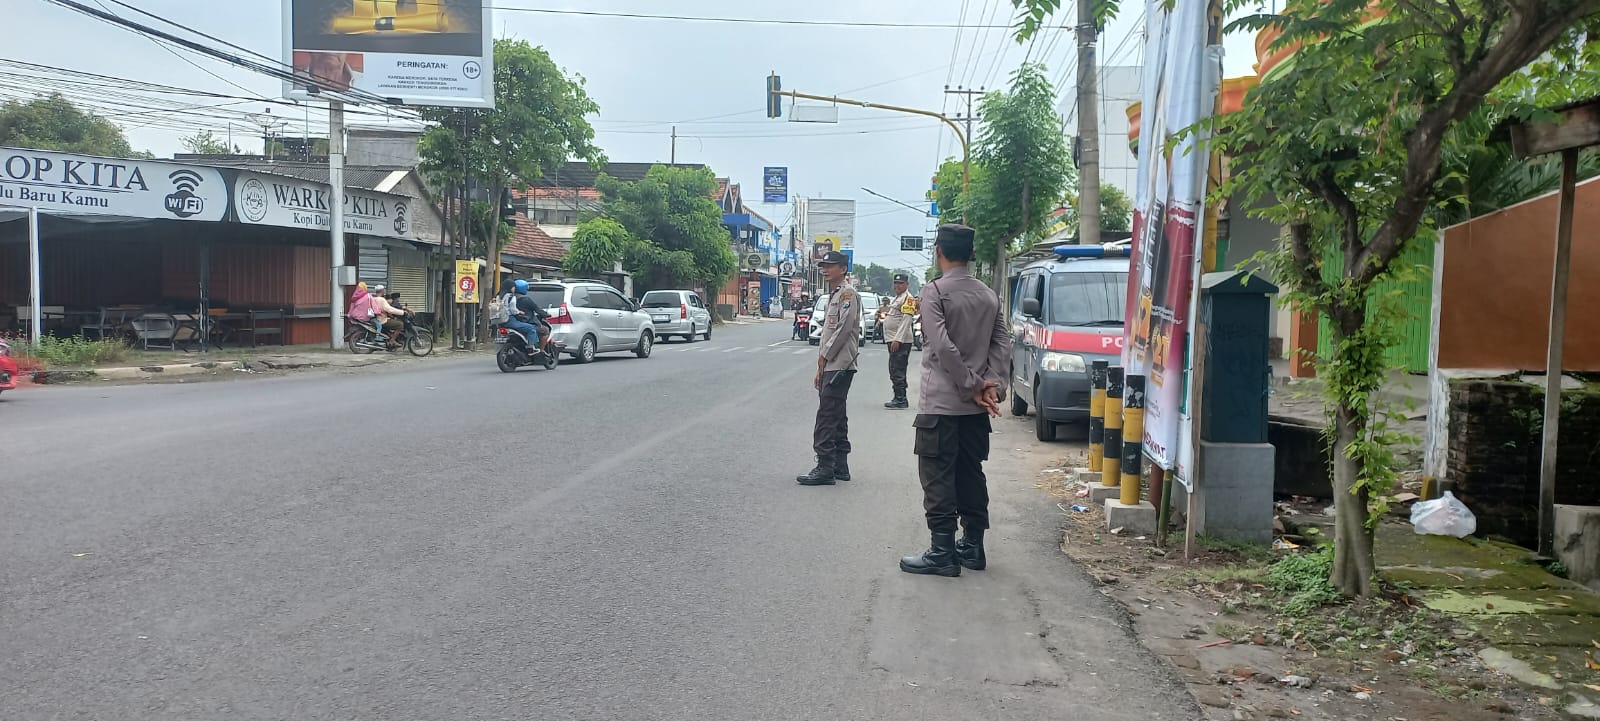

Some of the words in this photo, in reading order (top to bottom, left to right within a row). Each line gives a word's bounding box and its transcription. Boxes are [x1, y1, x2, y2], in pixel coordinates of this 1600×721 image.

[397, 61, 448, 70] PERINGATAN:
[61, 159, 150, 191] KITA
[20, 187, 56, 202] Baru
[61, 191, 109, 207] Kamu
[273, 184, 348, 210] WARKP
[352, 194, 388, 217] KITA
[294, 212, 313, 227] Kopi
[315, 215, 330, 226] Dul
[352, 220, 373, 230] Kamu
